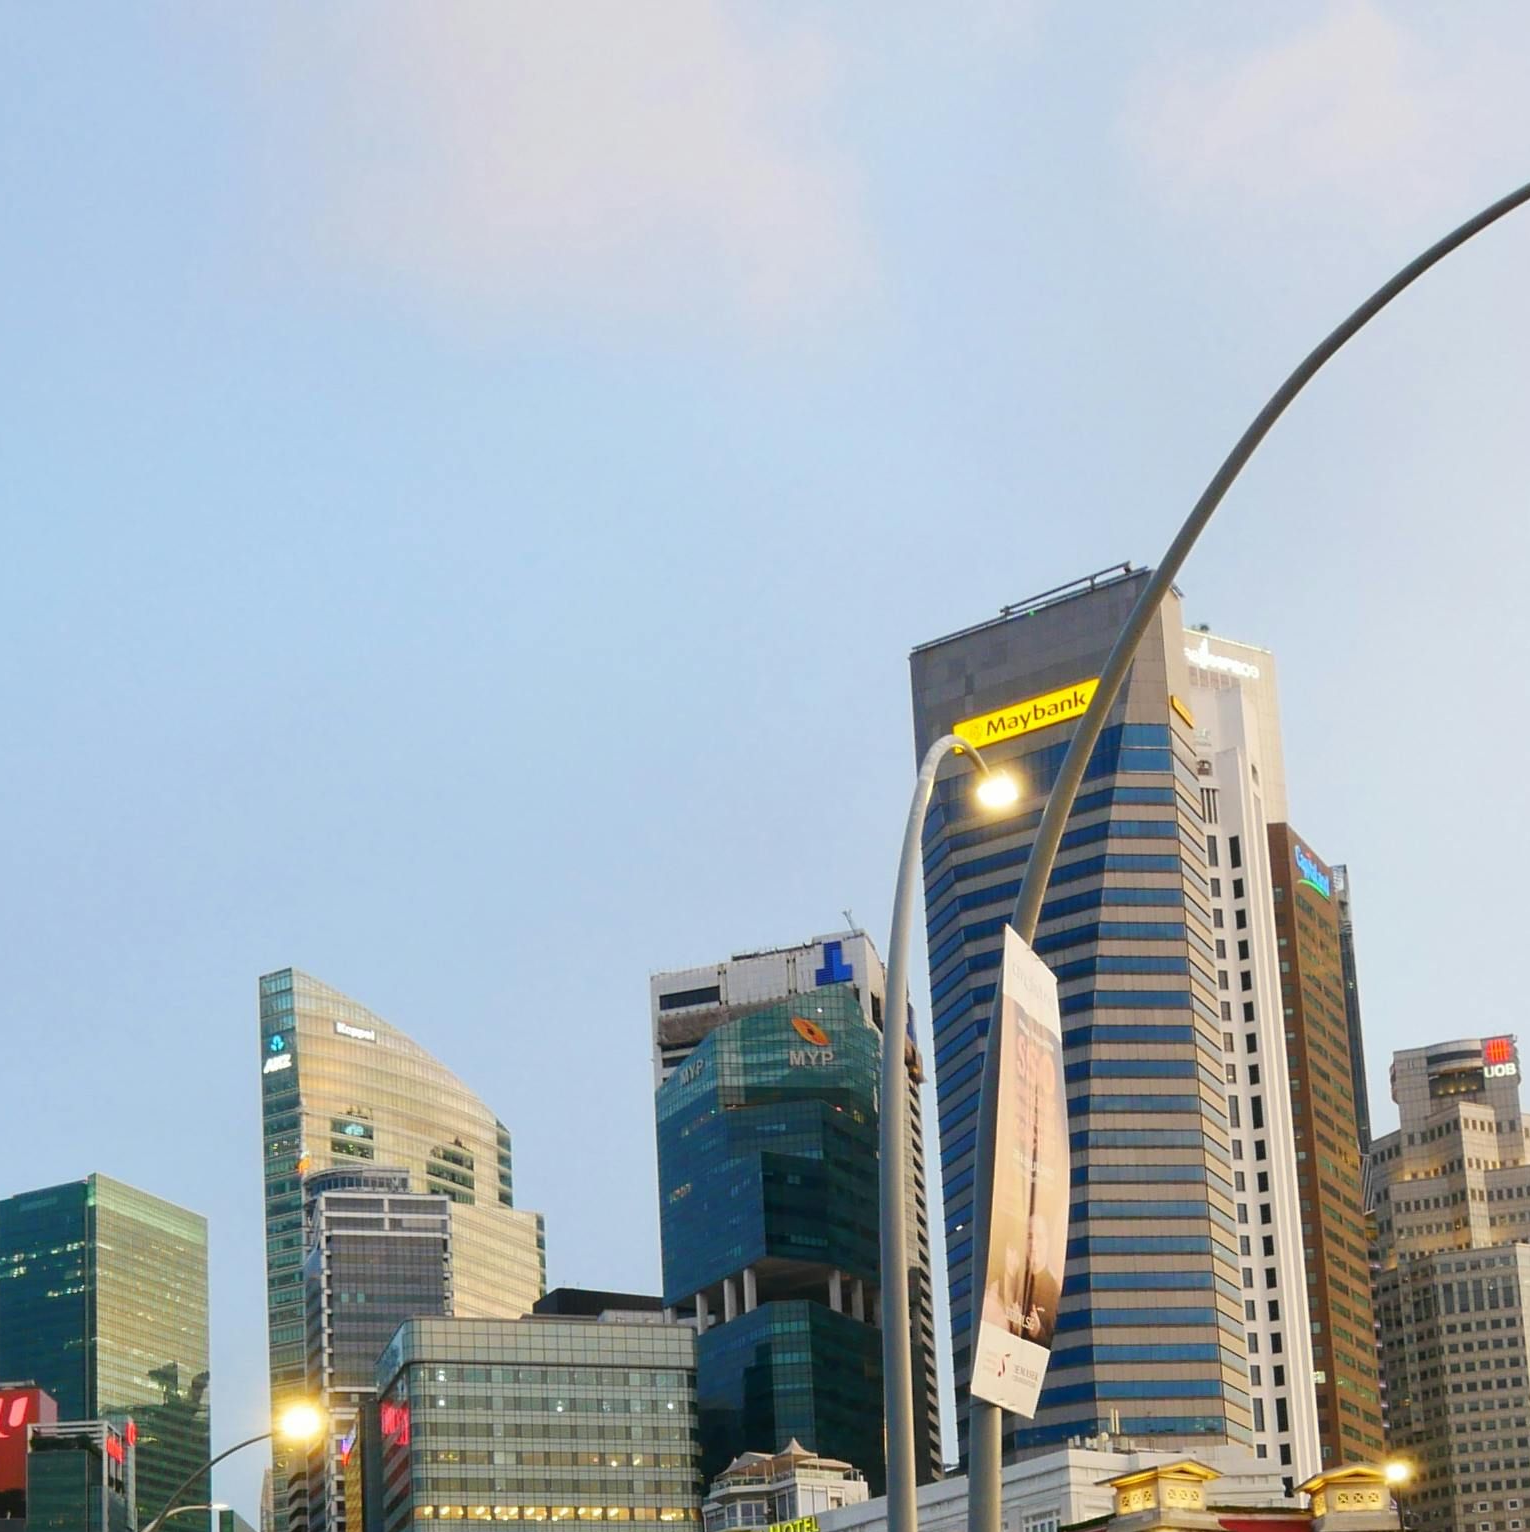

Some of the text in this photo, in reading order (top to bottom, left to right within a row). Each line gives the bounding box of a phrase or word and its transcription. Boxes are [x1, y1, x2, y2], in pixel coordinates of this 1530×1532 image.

[986, 691, 1086, 736] Maybank
[789, 1050, 834, 1067] MYP
[679, 1058, 704, 1085] MYP
[1483, 1063, 1517, 1078] UOB
